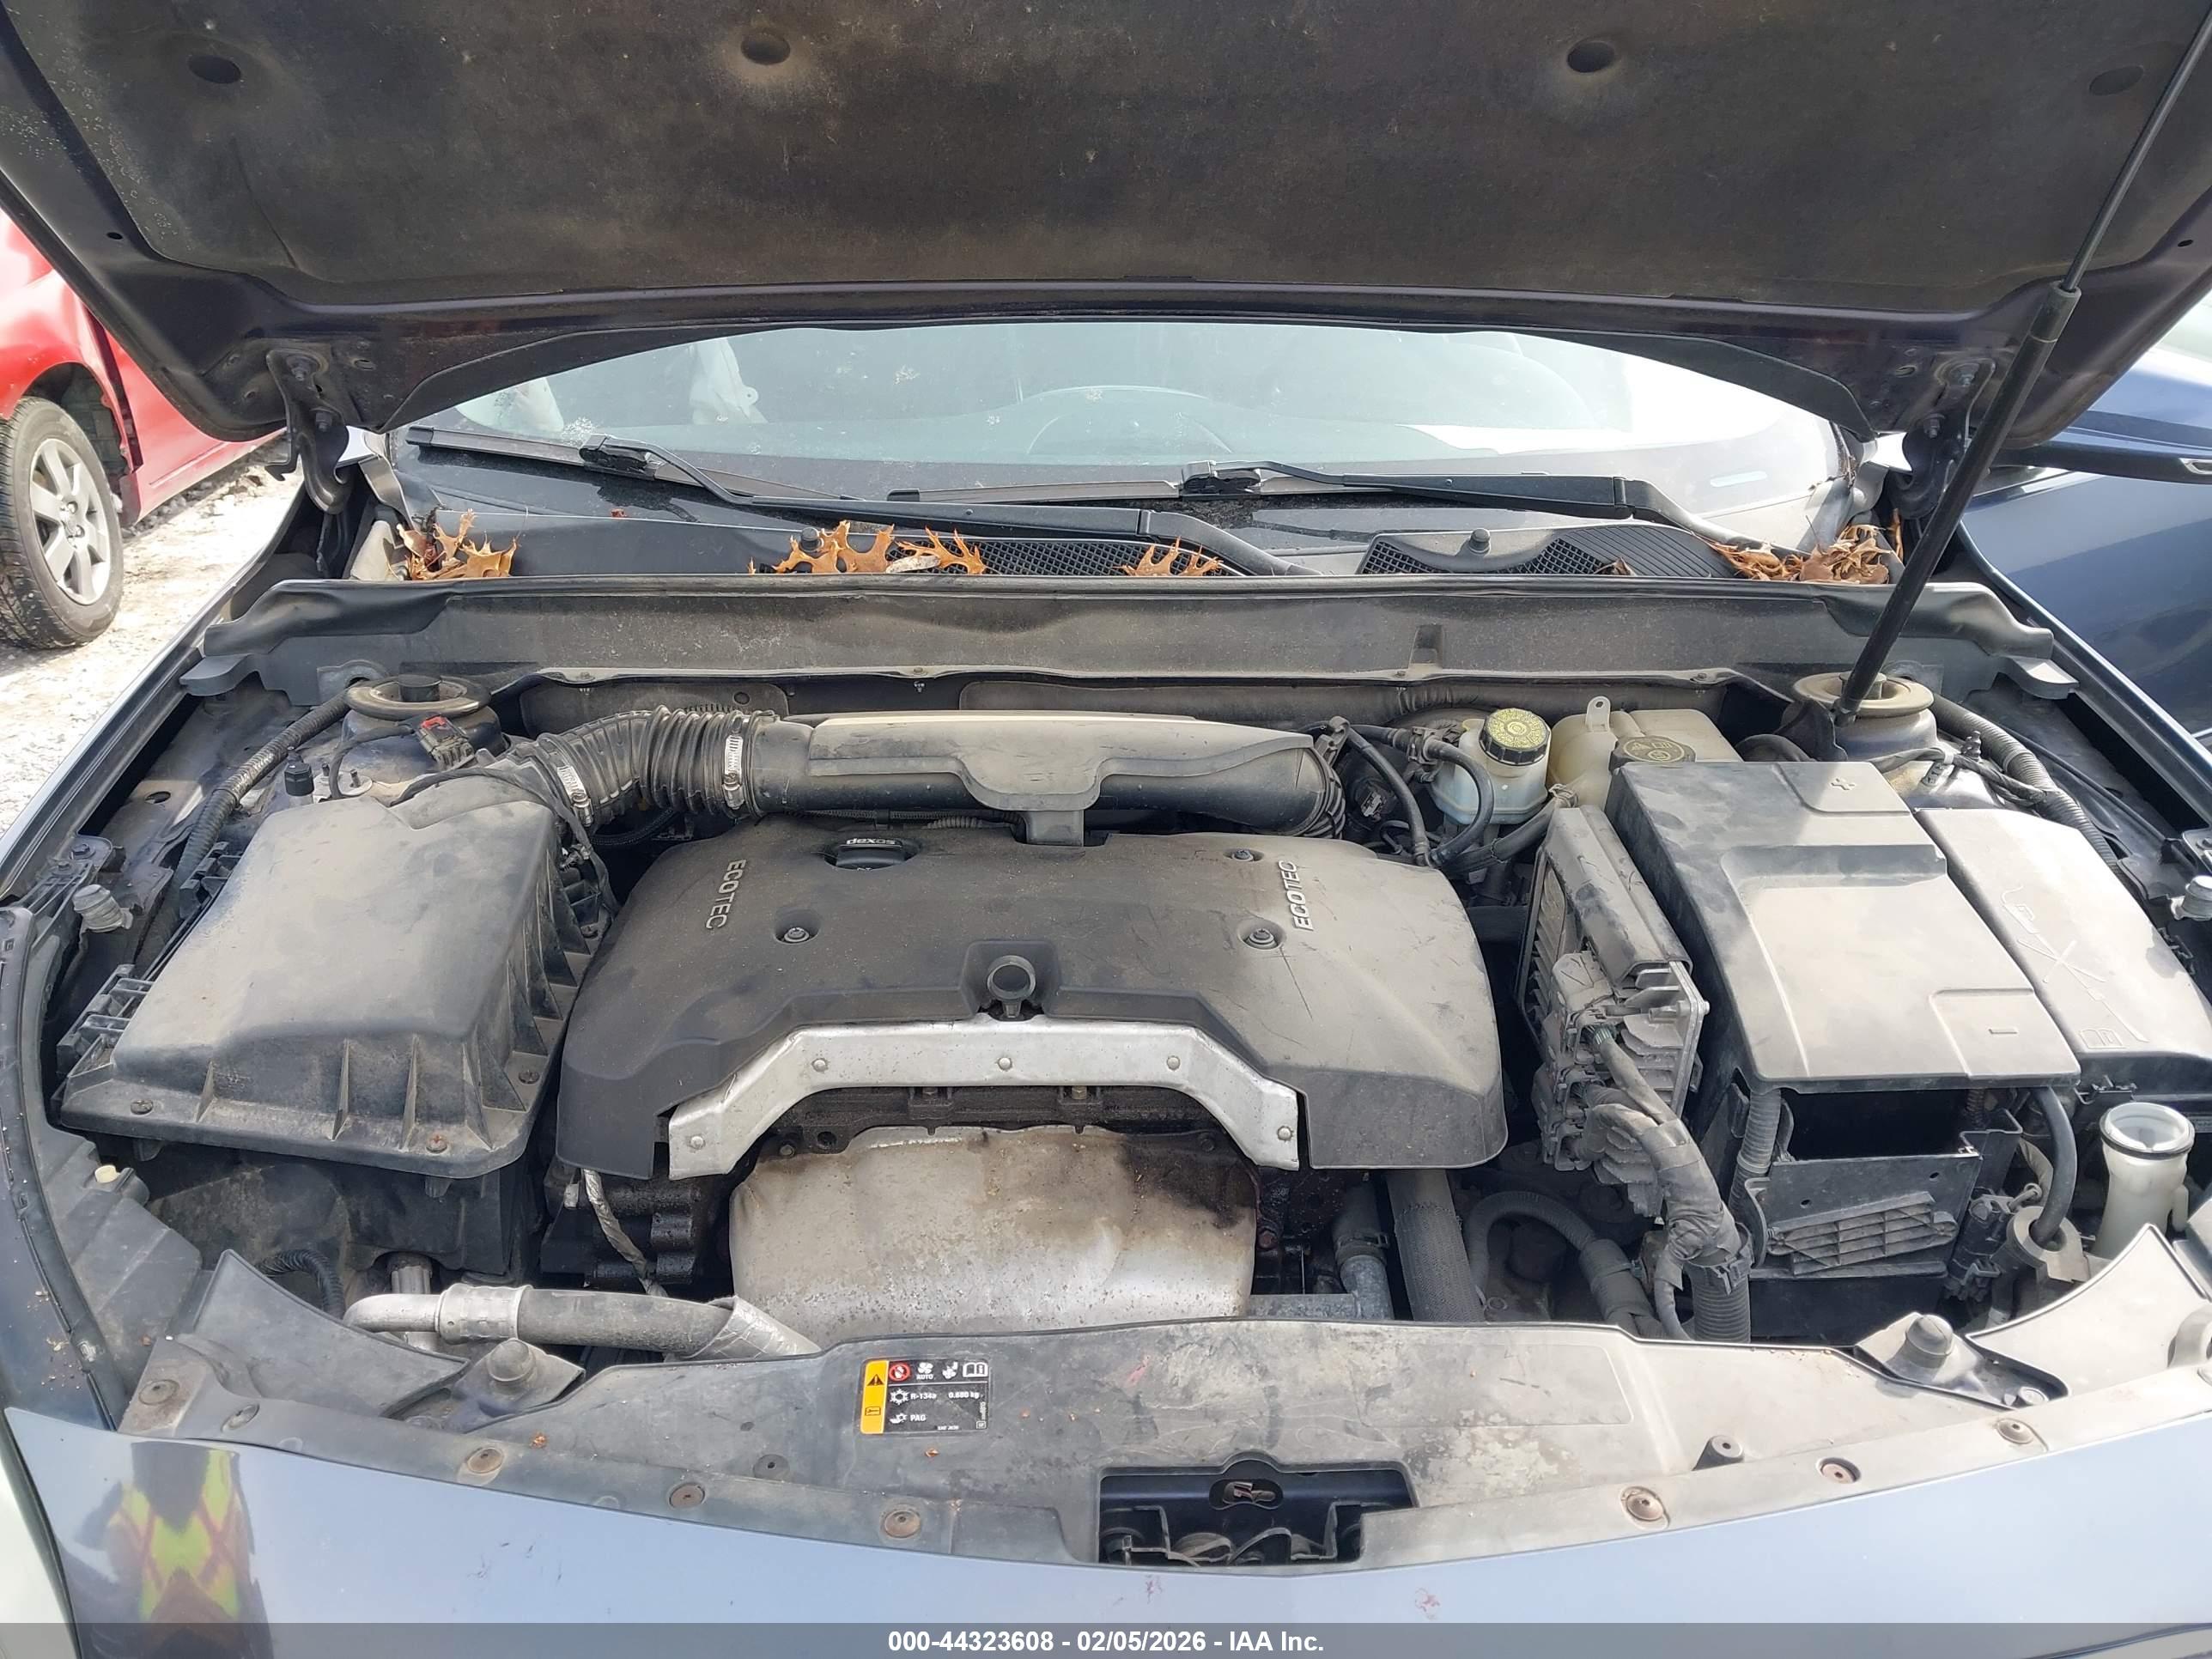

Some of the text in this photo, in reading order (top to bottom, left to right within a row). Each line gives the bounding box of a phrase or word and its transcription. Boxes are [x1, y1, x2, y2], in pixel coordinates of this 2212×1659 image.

[706, 859, 747, 929] ECOTEC
[1278, 860, 1314, 931] ECOTEC
[970, 1390, 980, 1399] kg
